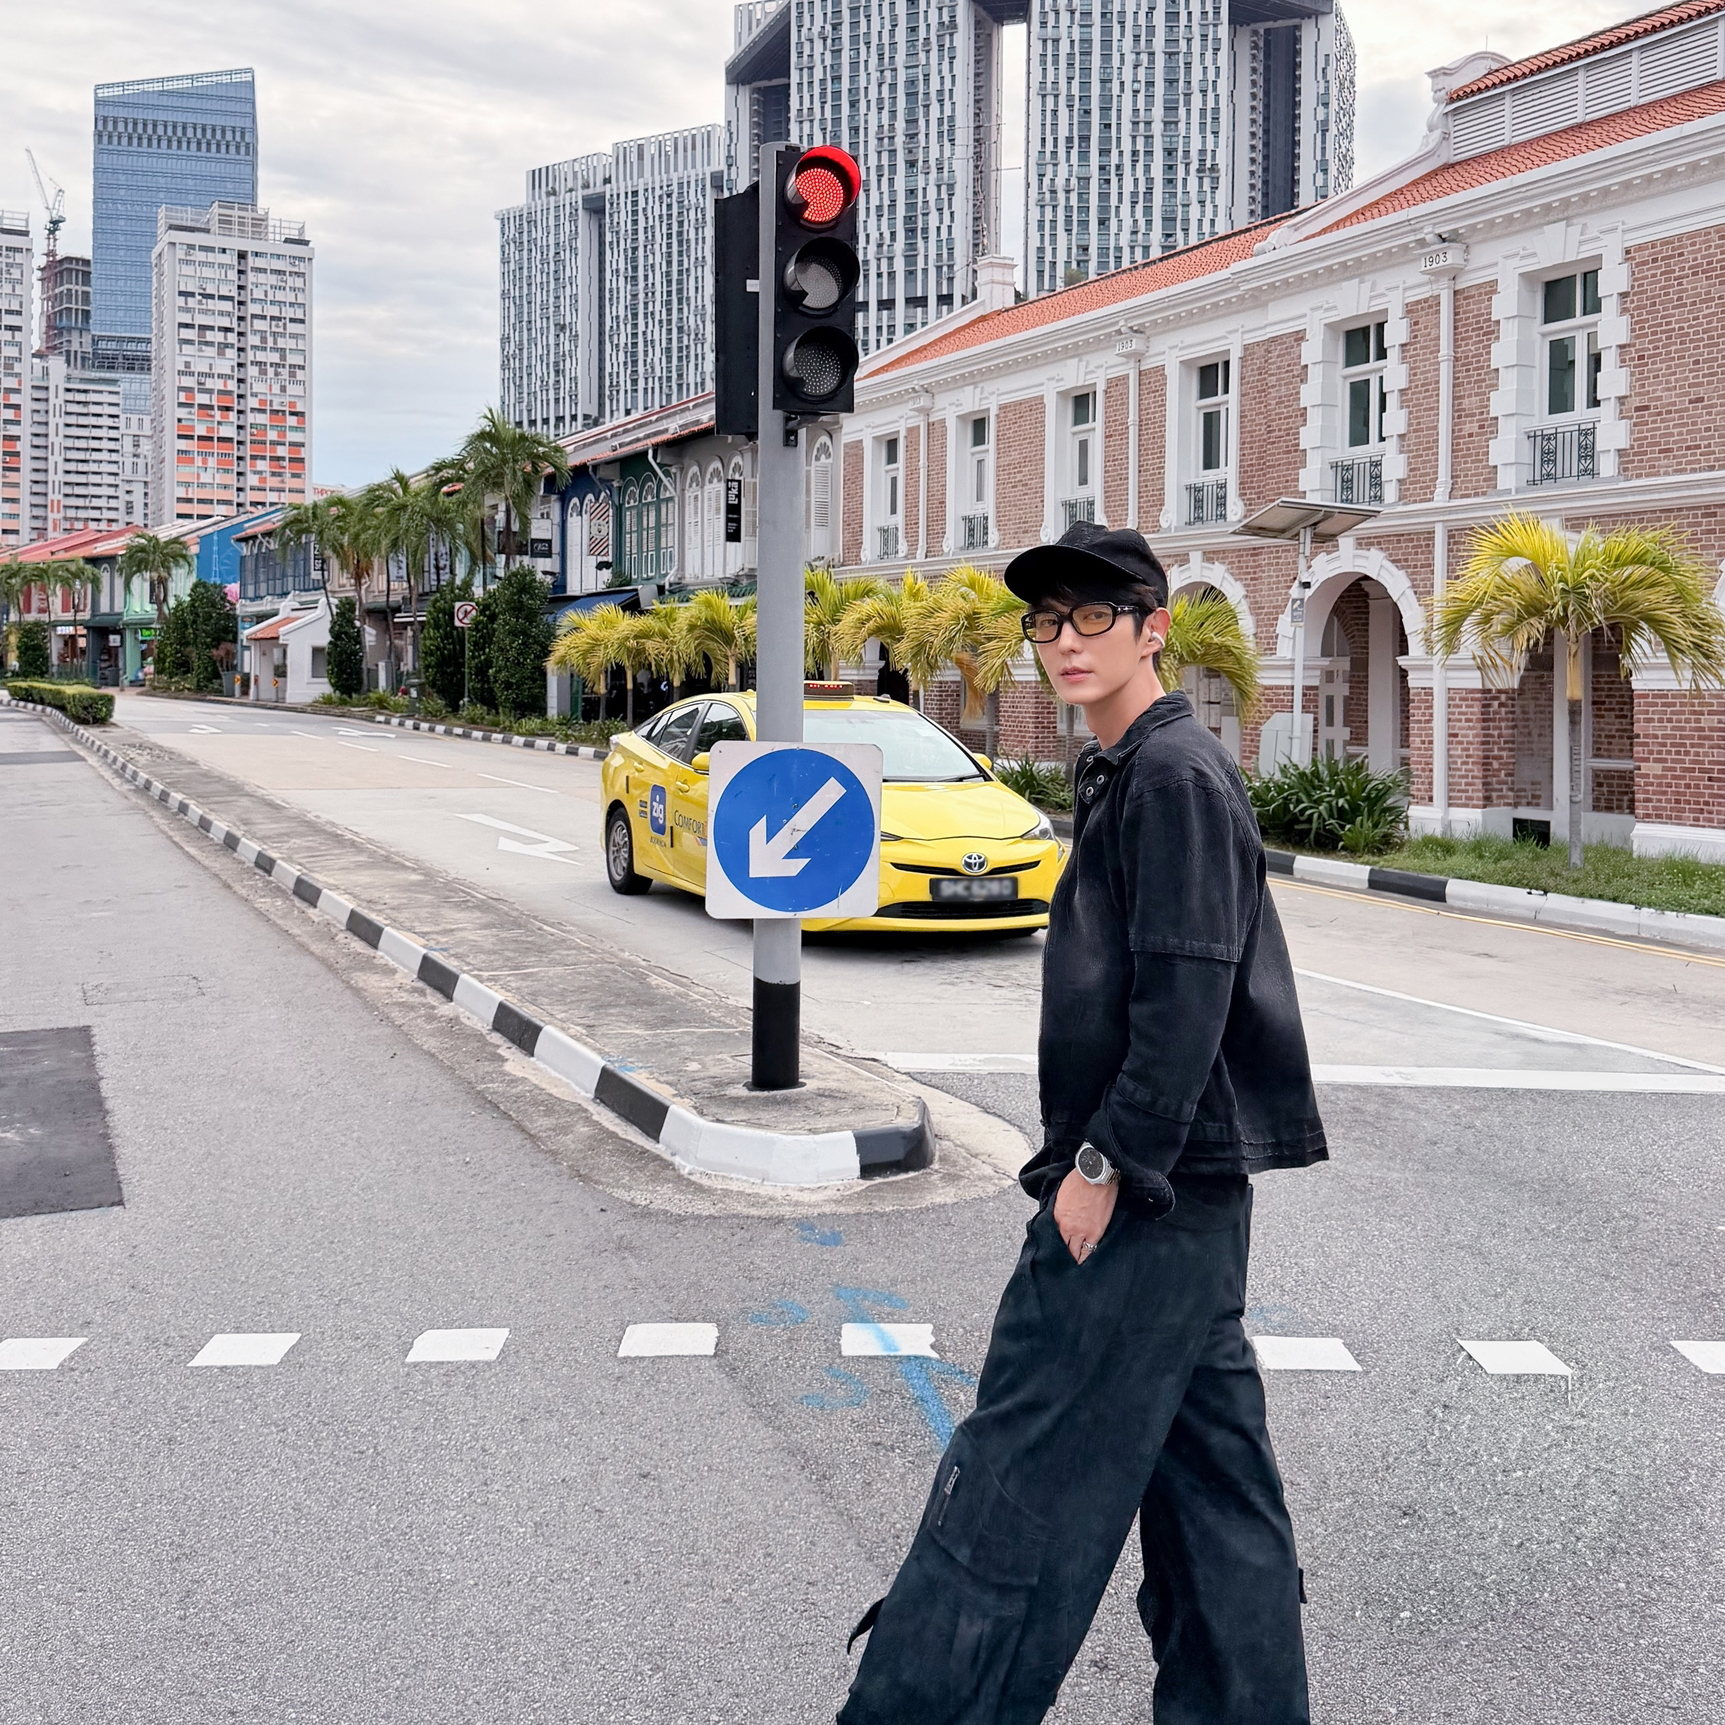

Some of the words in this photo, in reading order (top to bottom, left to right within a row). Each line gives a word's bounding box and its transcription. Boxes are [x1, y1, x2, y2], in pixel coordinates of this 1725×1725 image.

[1423, 251, 1448, 268] 1903
[1117, 339, 1133, 351] 1903
[652, 794, 664, 825] zig
[674, 809, 707, 837] COMFORT
